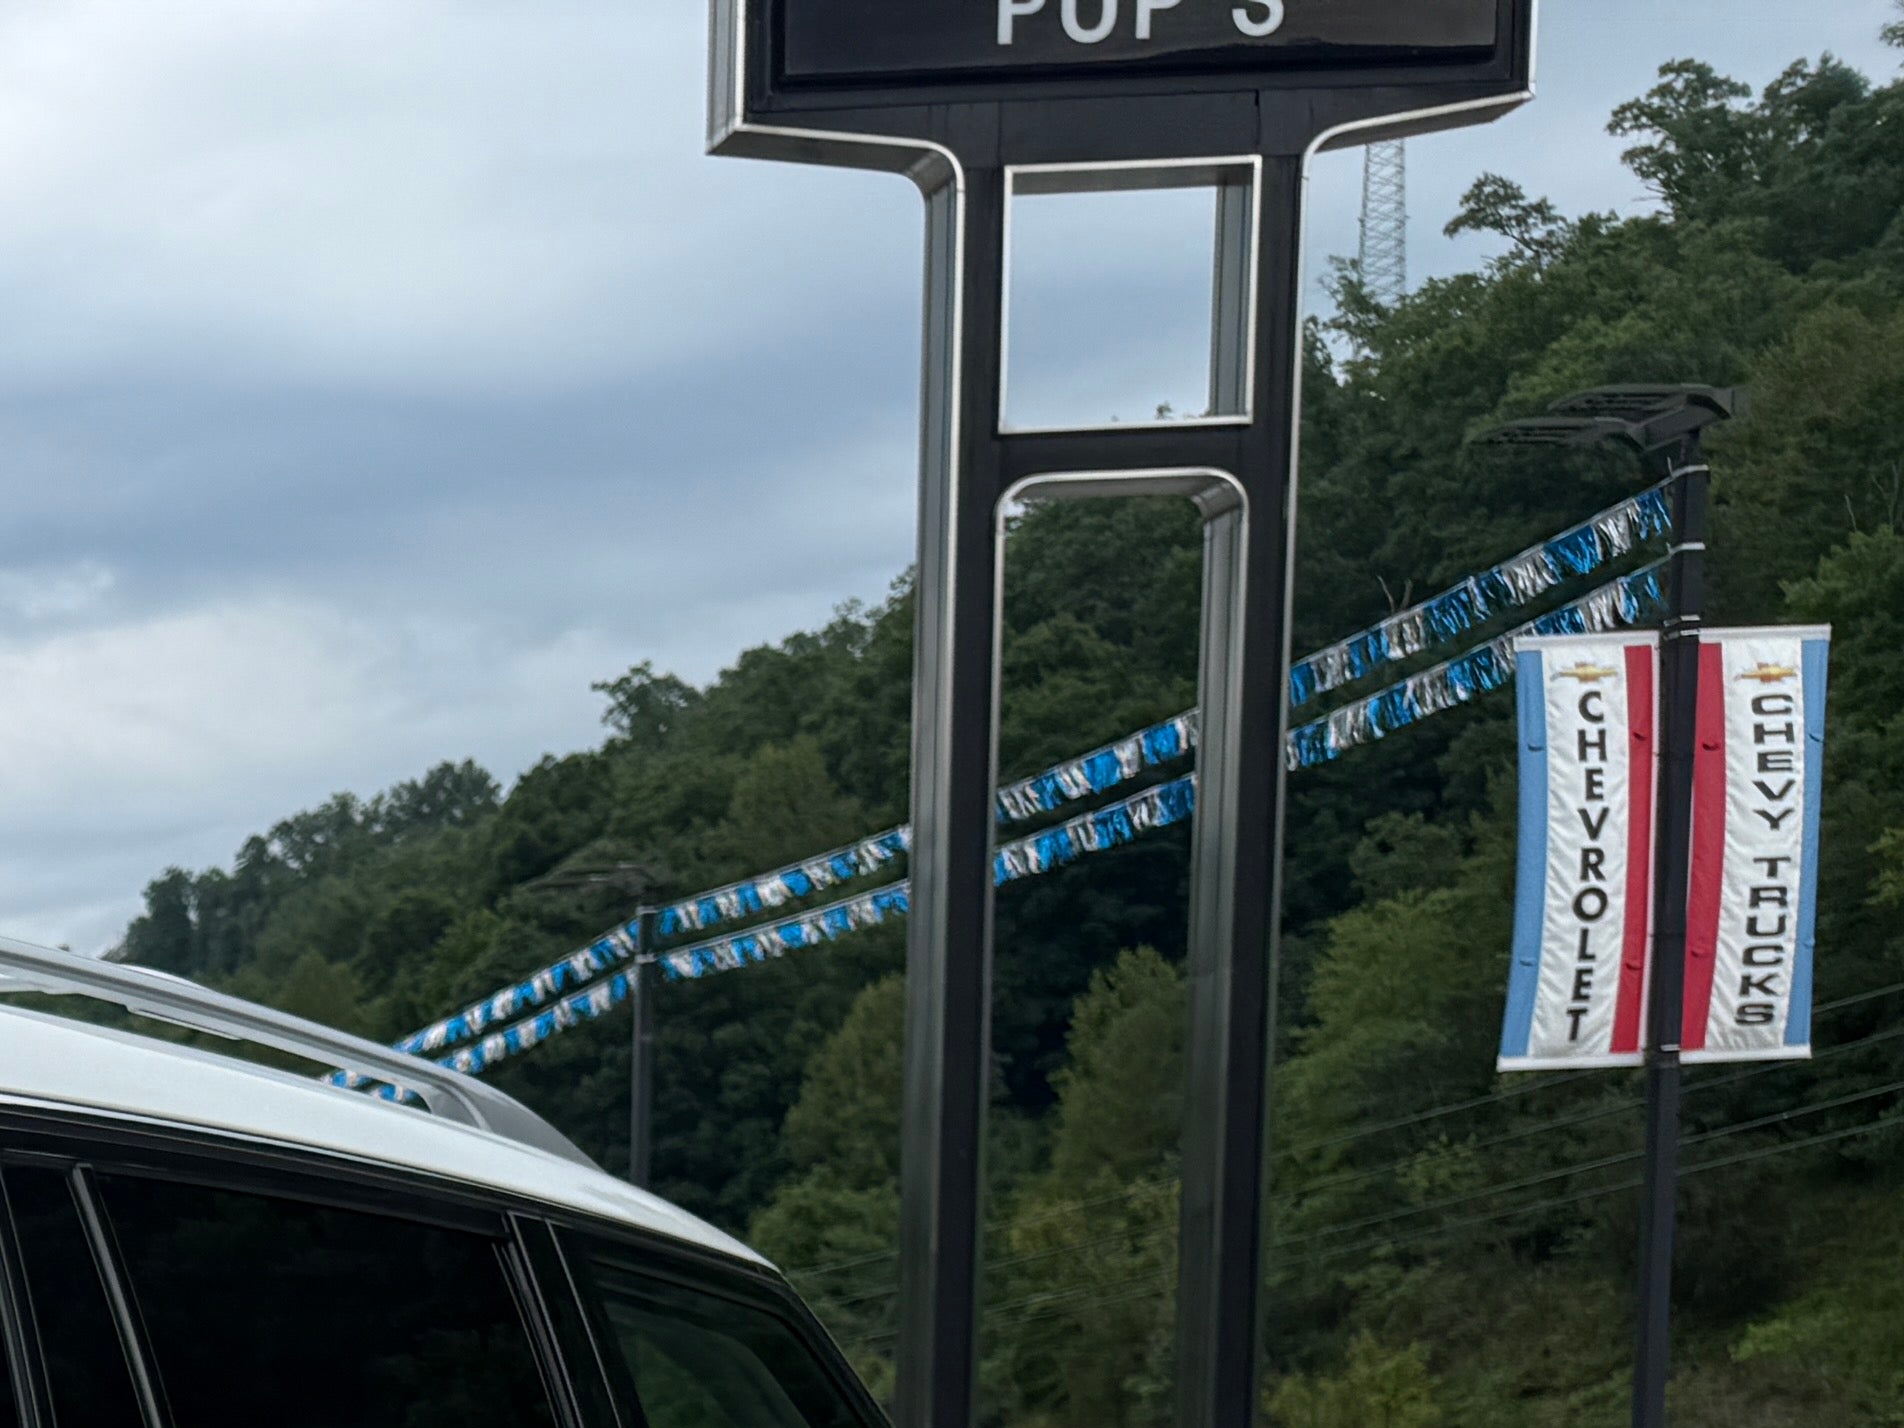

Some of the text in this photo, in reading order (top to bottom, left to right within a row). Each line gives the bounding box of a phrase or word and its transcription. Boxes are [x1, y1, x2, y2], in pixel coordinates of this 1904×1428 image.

[1566, 691, 1609, 1043] CHEVROLET
[1734, 694, 1795, 1027] CHEVY TRUCKS
